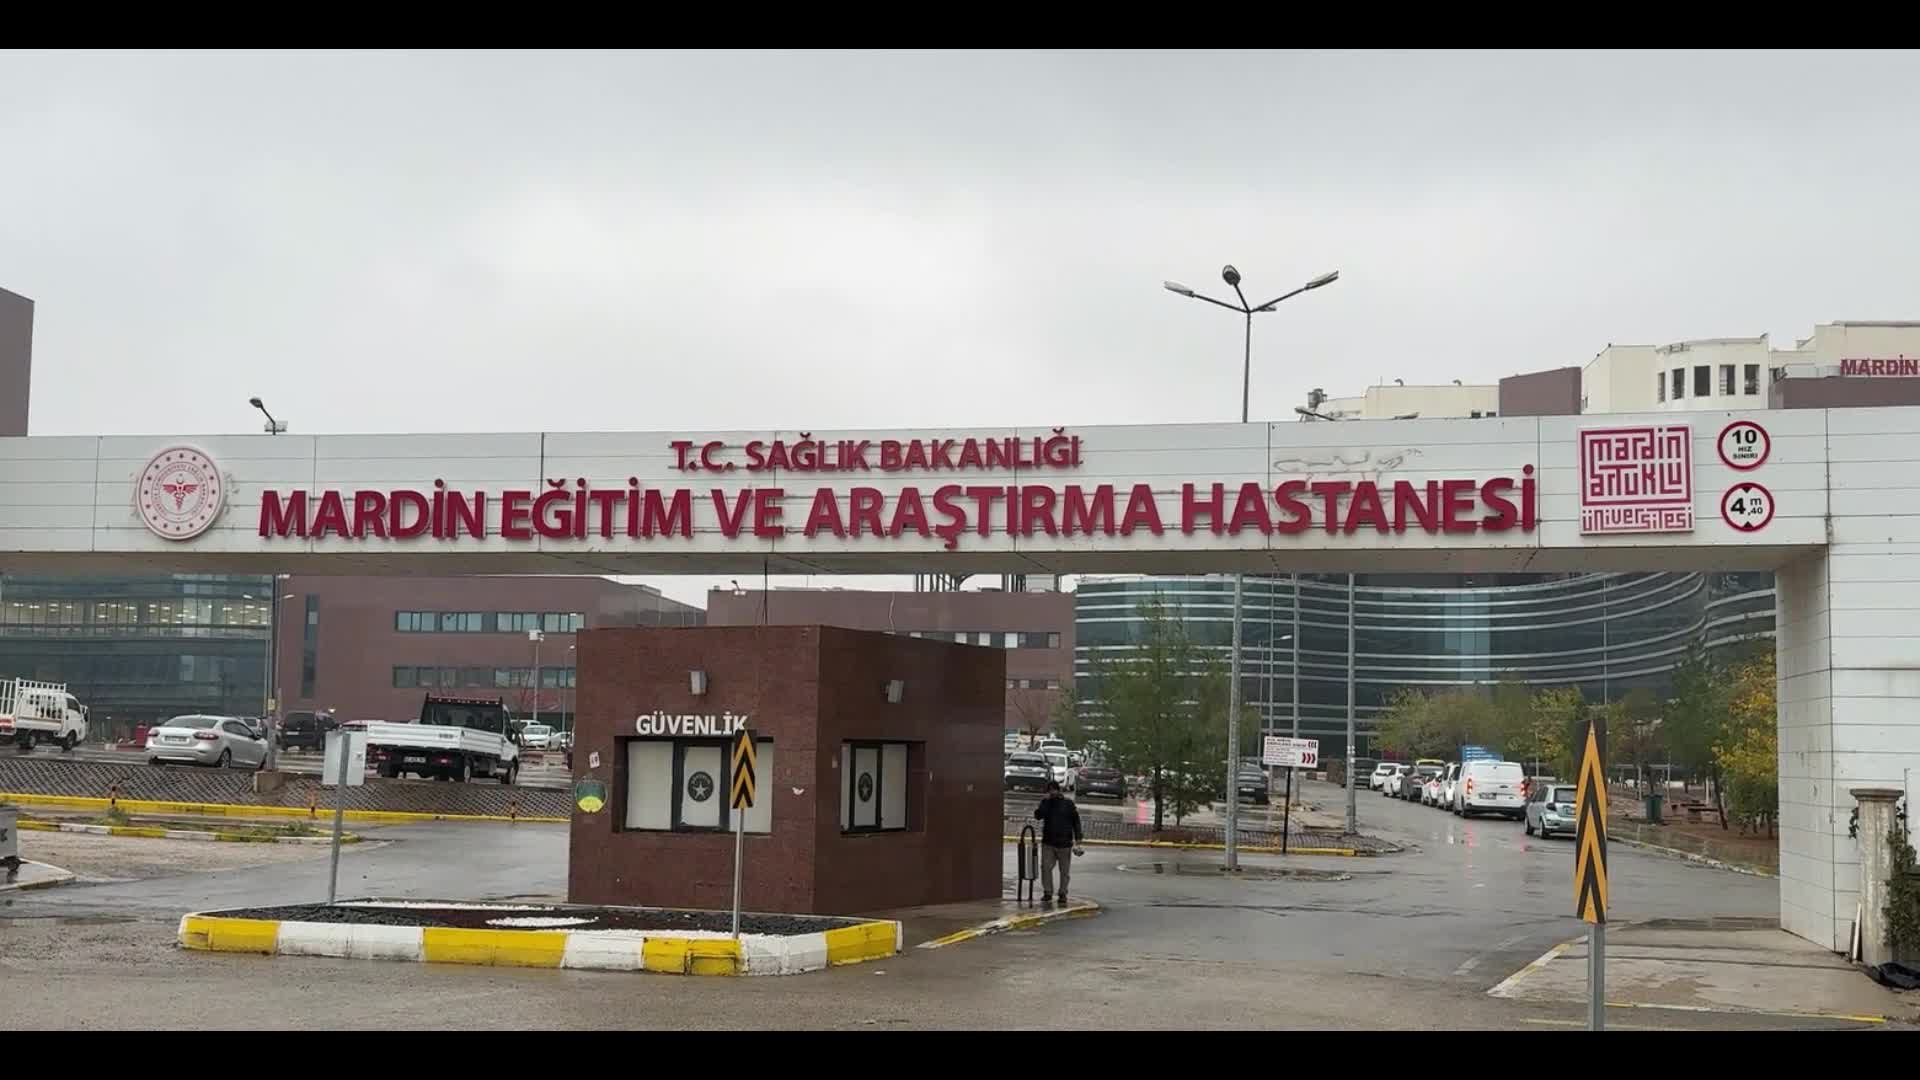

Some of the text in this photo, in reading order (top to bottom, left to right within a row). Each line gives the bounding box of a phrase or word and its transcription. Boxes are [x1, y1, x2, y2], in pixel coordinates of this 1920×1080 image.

[1840, 354, 1919, 376] MARDİN
[1732, 429, 1757, 445] 10
[671, 427, 1081, 471] T.C. SAĞLIK BAKANLIĞI
[258, 478, 486, 538] MARDİN
[501, 477, 695, 539] EĞİTİM
[711, 488, 785, 539] VE
[803, 484, 1164, 549] ARAŞTIRMA
[1181, 463, 1536, 536] HASTANESİ
[1730, 497, 1746, 515] 4
[636, 710, 748, 735] GÜVENLİK
